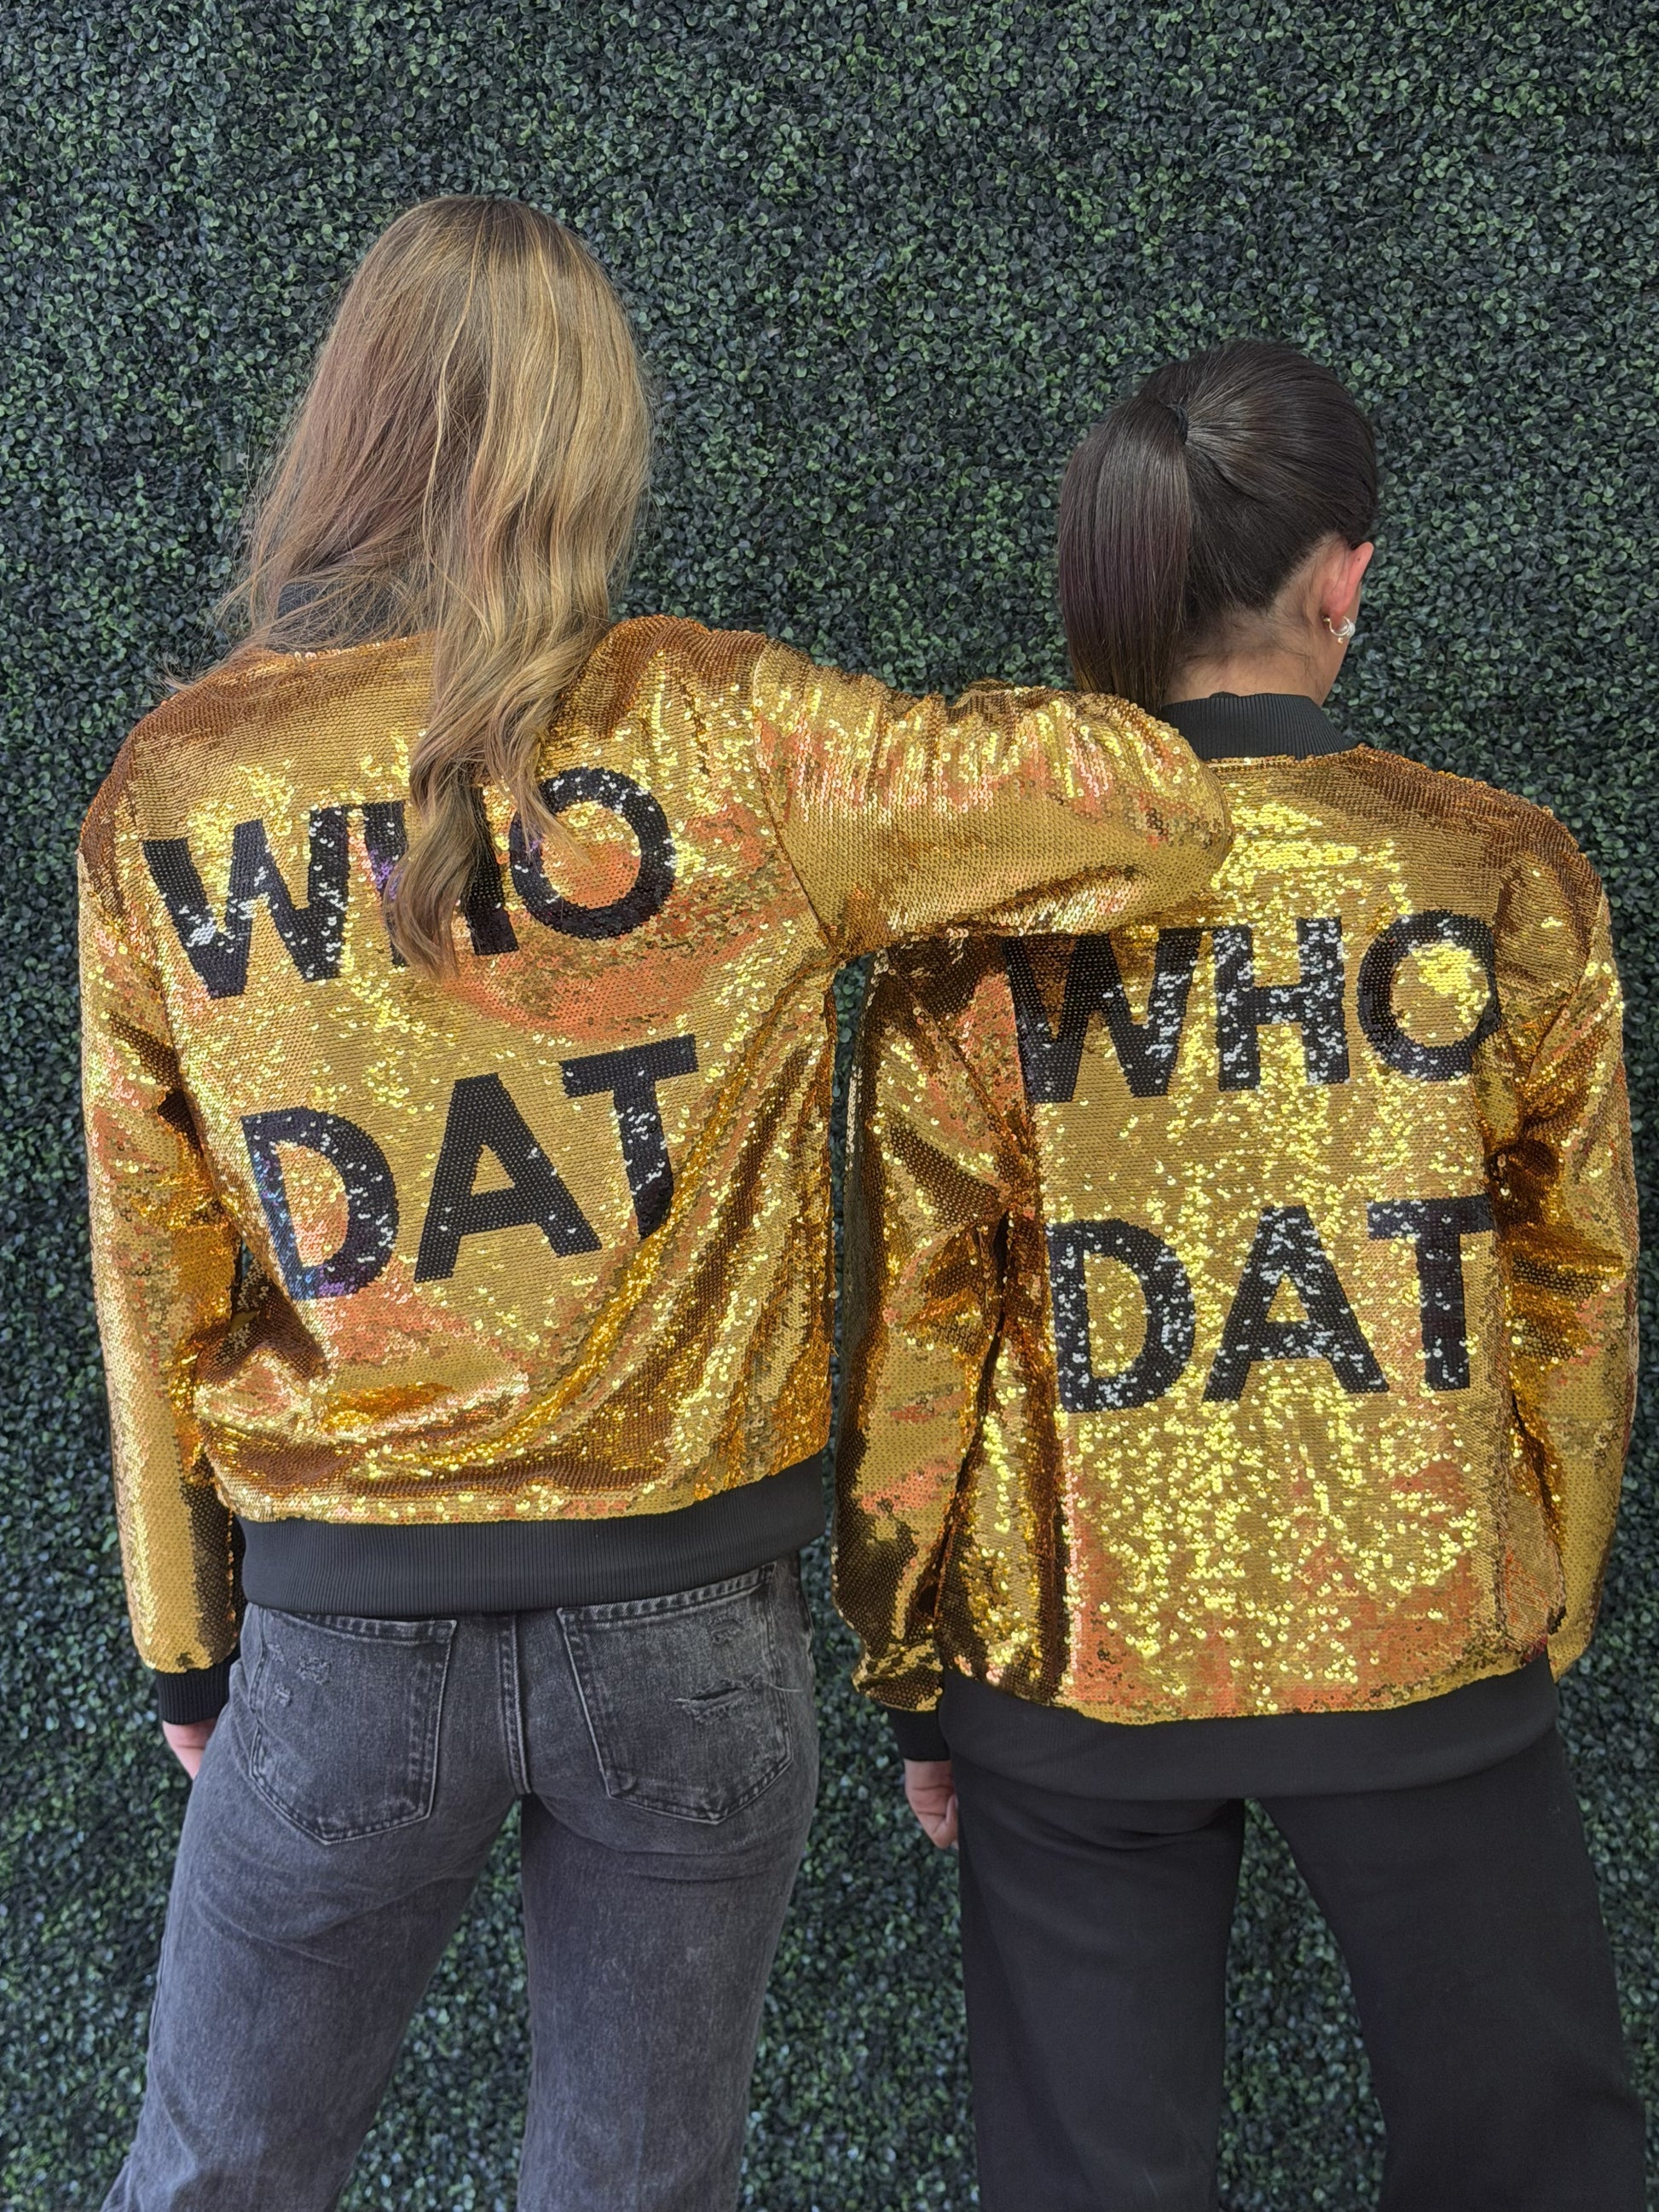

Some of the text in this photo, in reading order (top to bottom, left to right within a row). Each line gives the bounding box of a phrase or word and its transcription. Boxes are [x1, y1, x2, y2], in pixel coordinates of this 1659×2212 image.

[1002, 909, 1501, 1103] WHO
[240, 1034, 700, 1301] DAT
[1047, 1195, 1497, 1414] DAT
